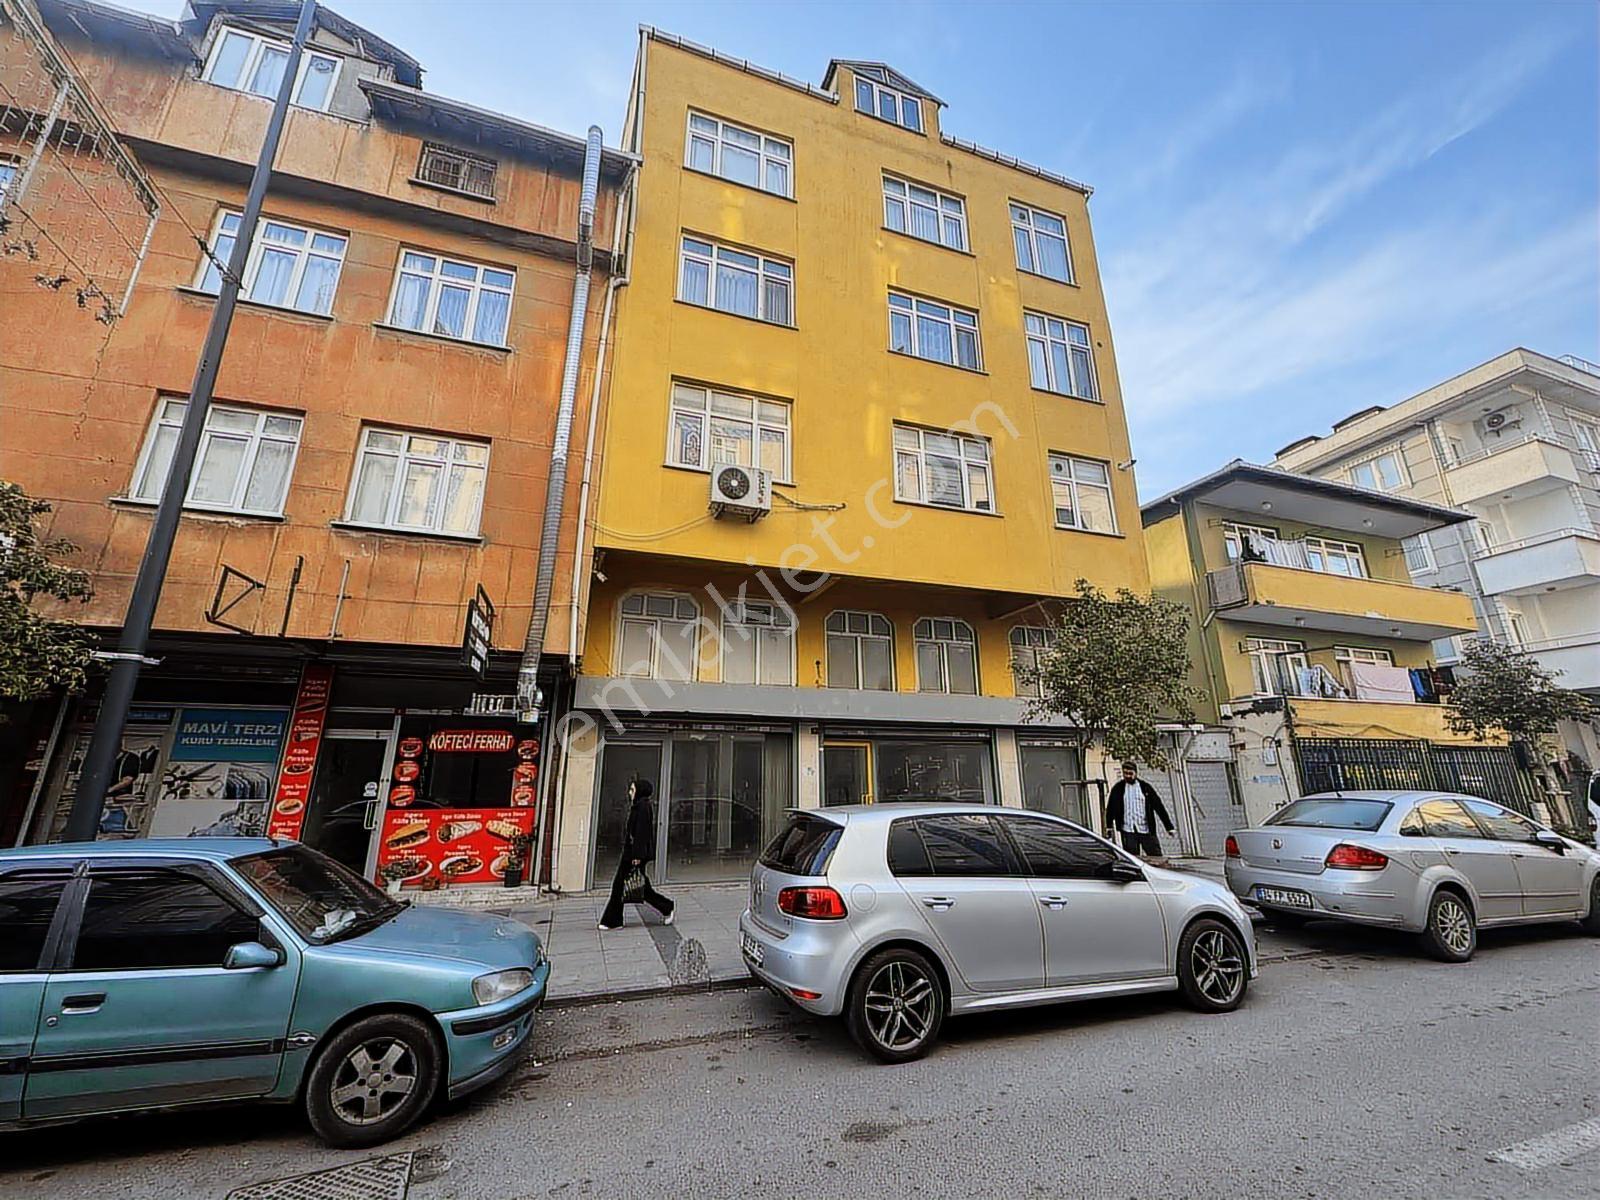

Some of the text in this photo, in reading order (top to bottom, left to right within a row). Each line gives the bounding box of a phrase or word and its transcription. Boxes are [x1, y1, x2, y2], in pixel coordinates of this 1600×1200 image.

[183, 721, 282, 735] MAVİ TERZİ
[429, 731, 474, 750] KÖFTECİ
[473, 734, 513, 750] FERHAT
